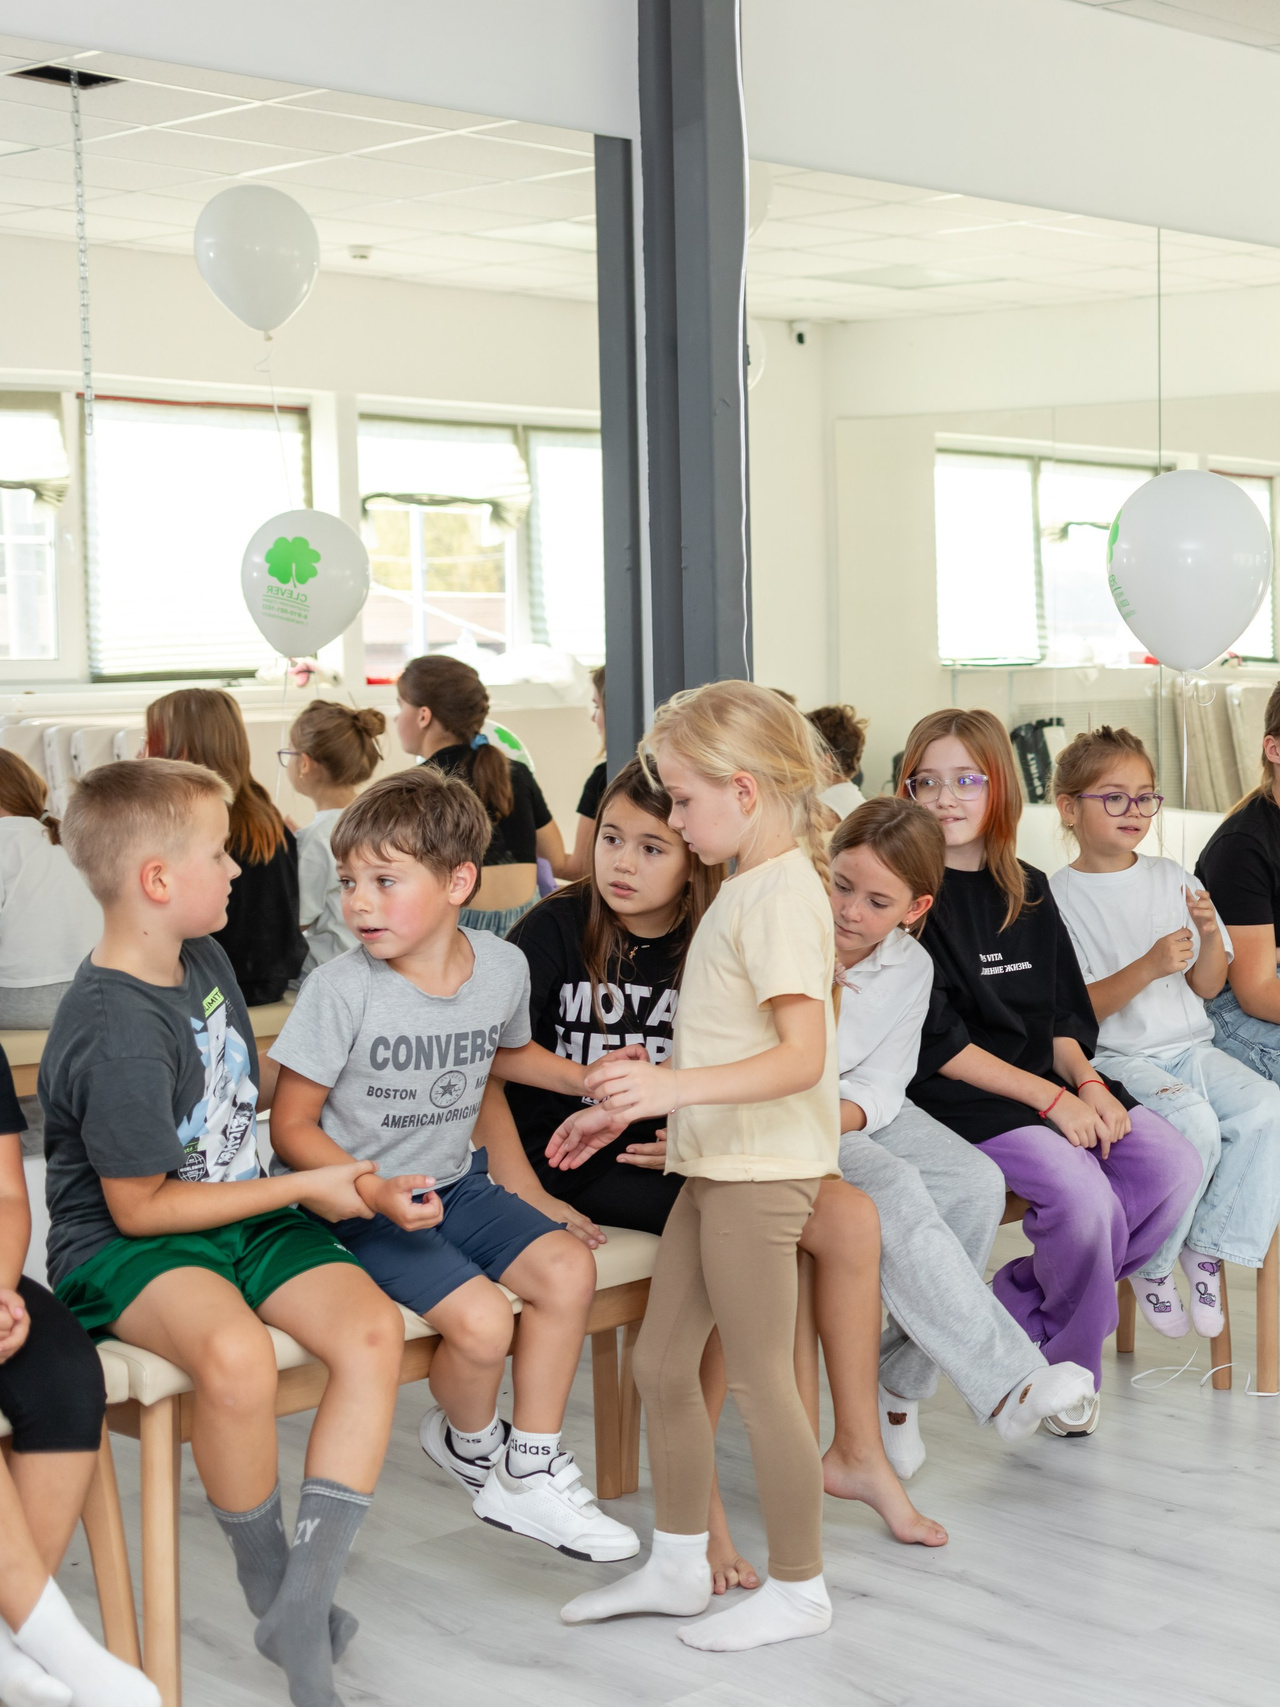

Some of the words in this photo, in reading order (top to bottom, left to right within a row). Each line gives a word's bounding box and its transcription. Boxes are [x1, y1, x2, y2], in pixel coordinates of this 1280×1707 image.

[986, 952, 1003, 962] VITA
[1004, 961, 1033, 973] ЖИЗНЬ
[366, 1085, 417, 1100] BOSTON
[380, 1103, 446, 1129] AMERICAN
[509, 1438, 551, 1456] didas
